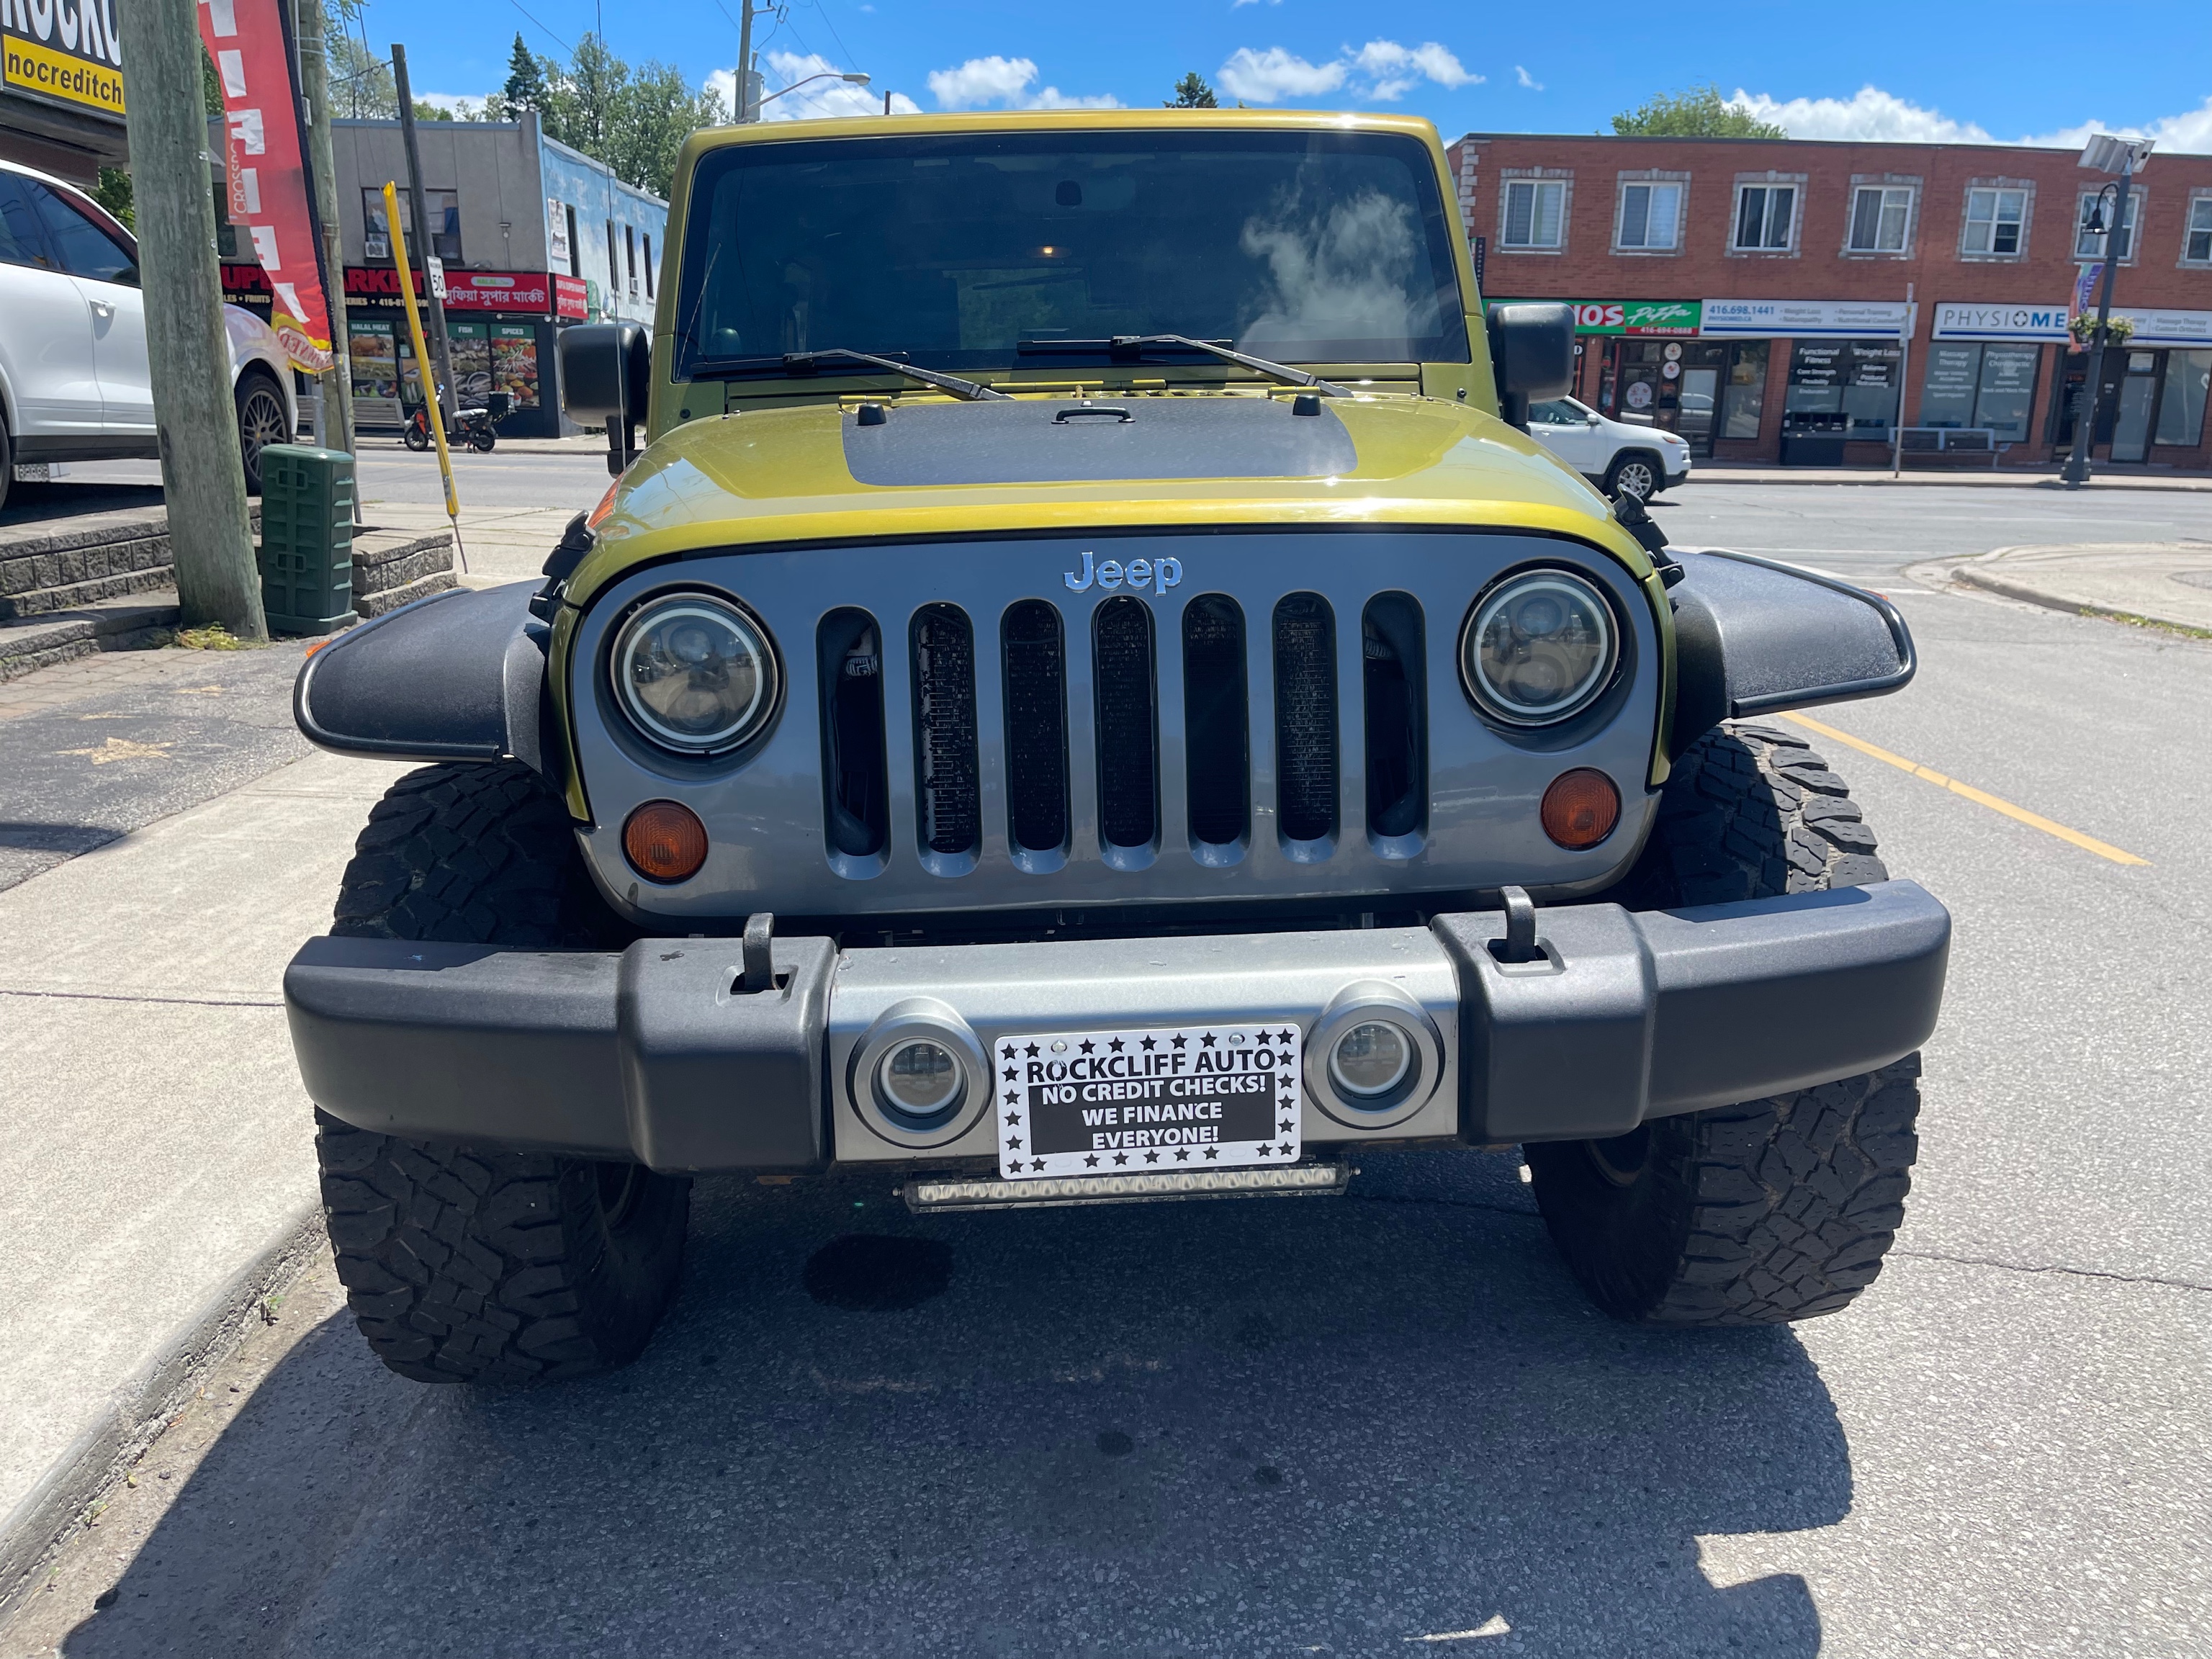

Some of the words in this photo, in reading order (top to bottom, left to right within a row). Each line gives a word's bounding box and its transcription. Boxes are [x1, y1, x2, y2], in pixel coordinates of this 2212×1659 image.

[8, 52, 122, 104] nocreditch
[433, 274, 444, 292] 50
[245, 294, 271, 304] FRUITS
[1709, 305, 1774, 315] 416.698.1441
[1627, 305, 1692, 324] Pizza
[1064, 551, 1183, 597] Jeep
[1027, 1053, 1187, 1084] ROCKCLIFF
[1195, 1048, 1276, 1074] AUTO
[1042, 1086, 1077, 1105] NO
[1082, 1080, 1164, 1102] CREDIT
[1169, 1075, 1267, 1097] CHECKS!
[1082, 1108, 1118, 1126] WE
[1123, 1102, 1223, 1124] FINANCE
[1092, 1126, 1219, 1149] EVERYONE!
